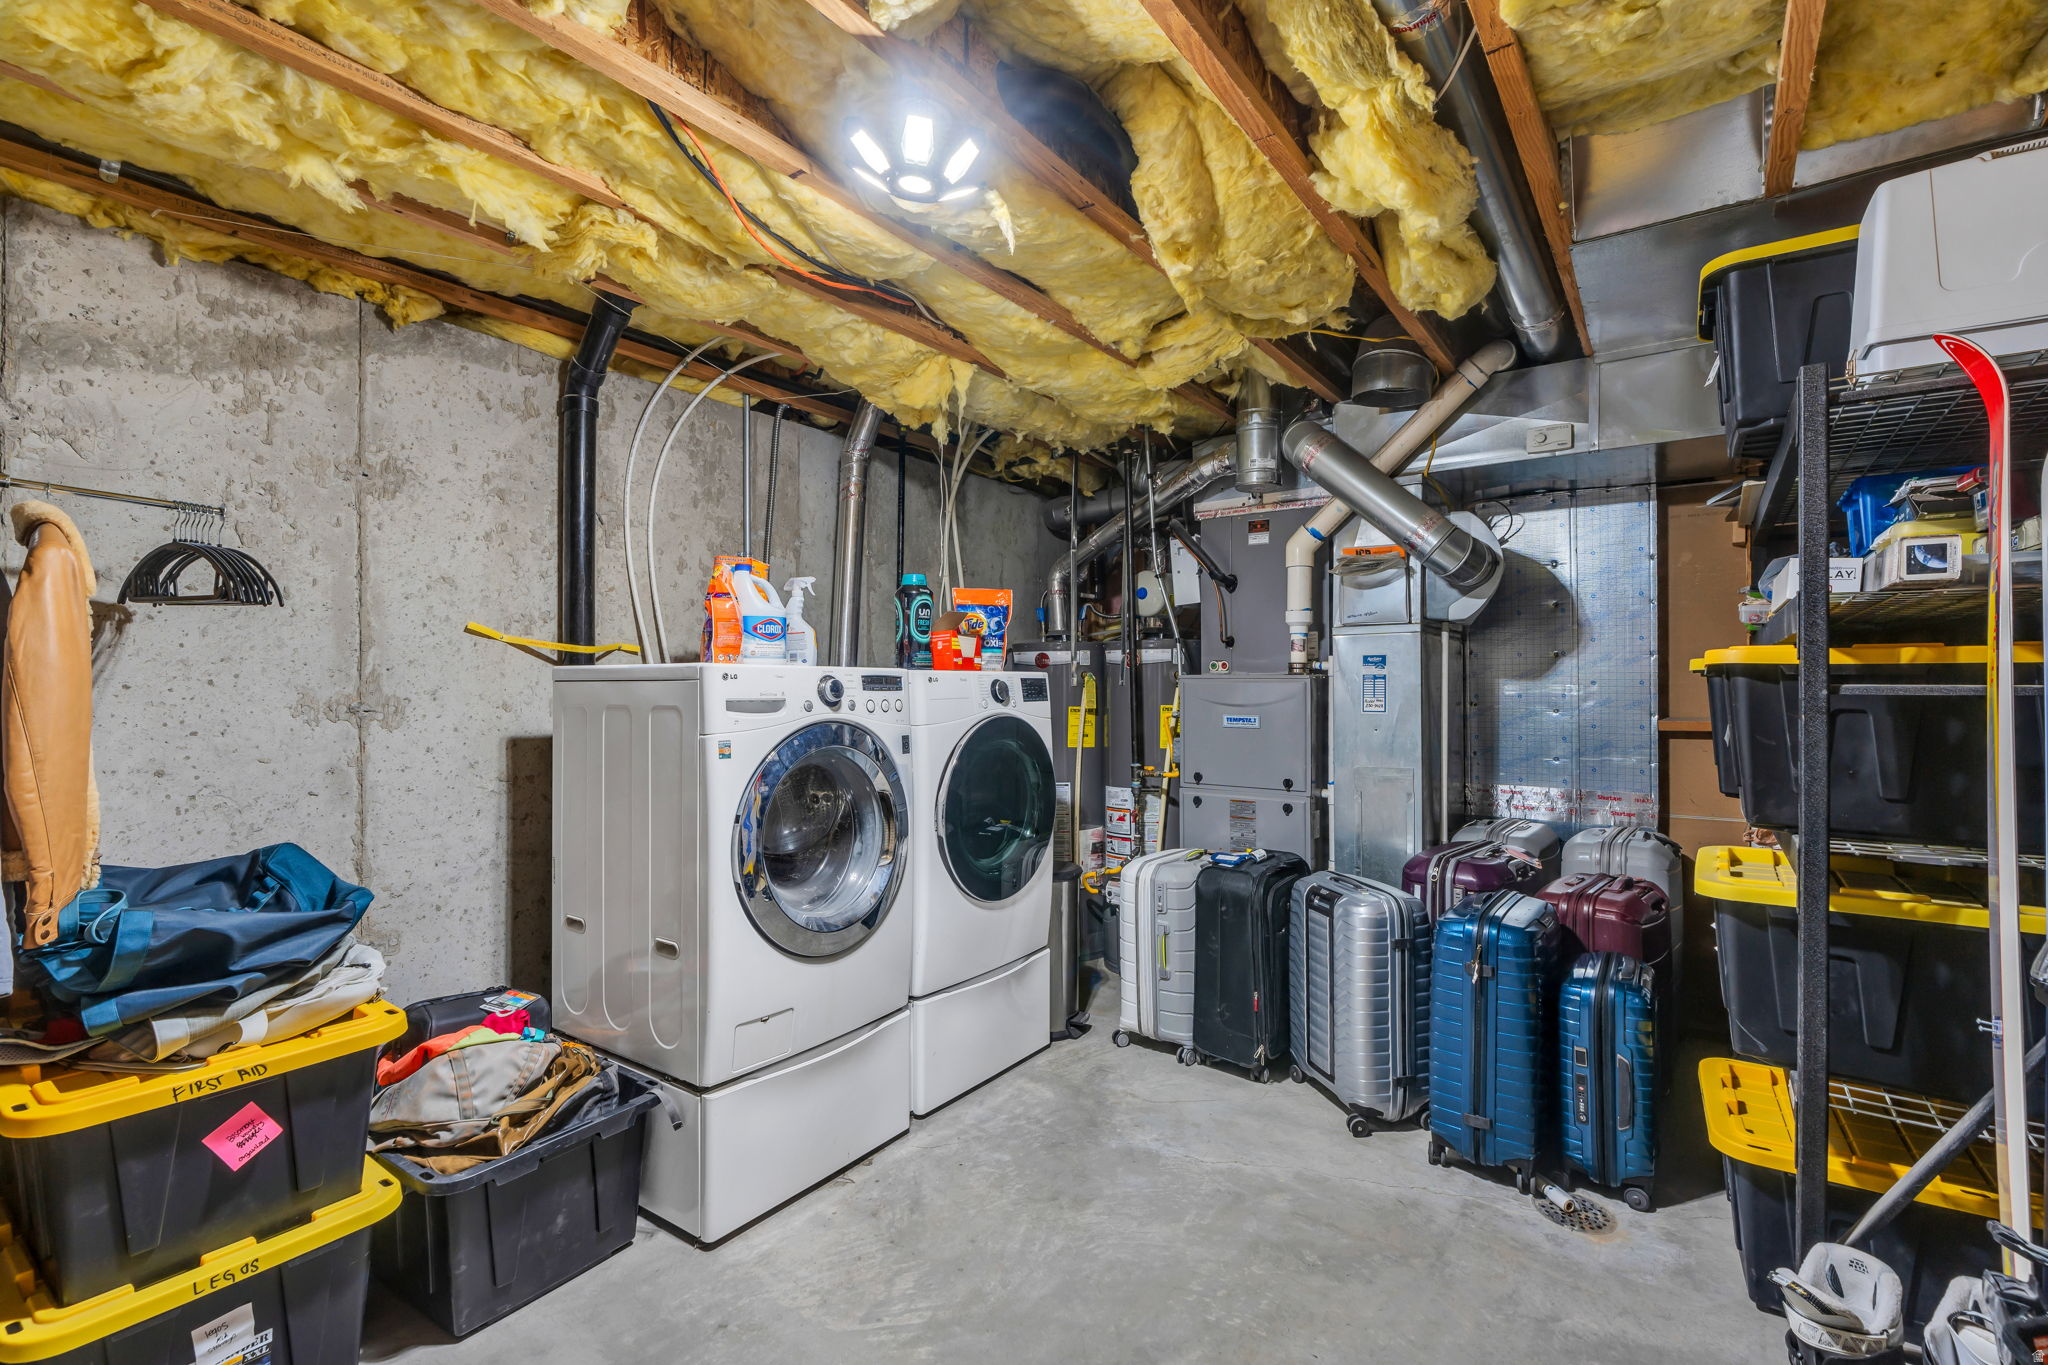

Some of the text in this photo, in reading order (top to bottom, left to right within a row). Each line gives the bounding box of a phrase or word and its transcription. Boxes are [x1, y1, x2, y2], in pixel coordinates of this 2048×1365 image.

[963, 617, 984, 629] Tide
[173, 1064, 268, 1102] FIRST AID
[193, 1258, 259, 1296] LEGOS
